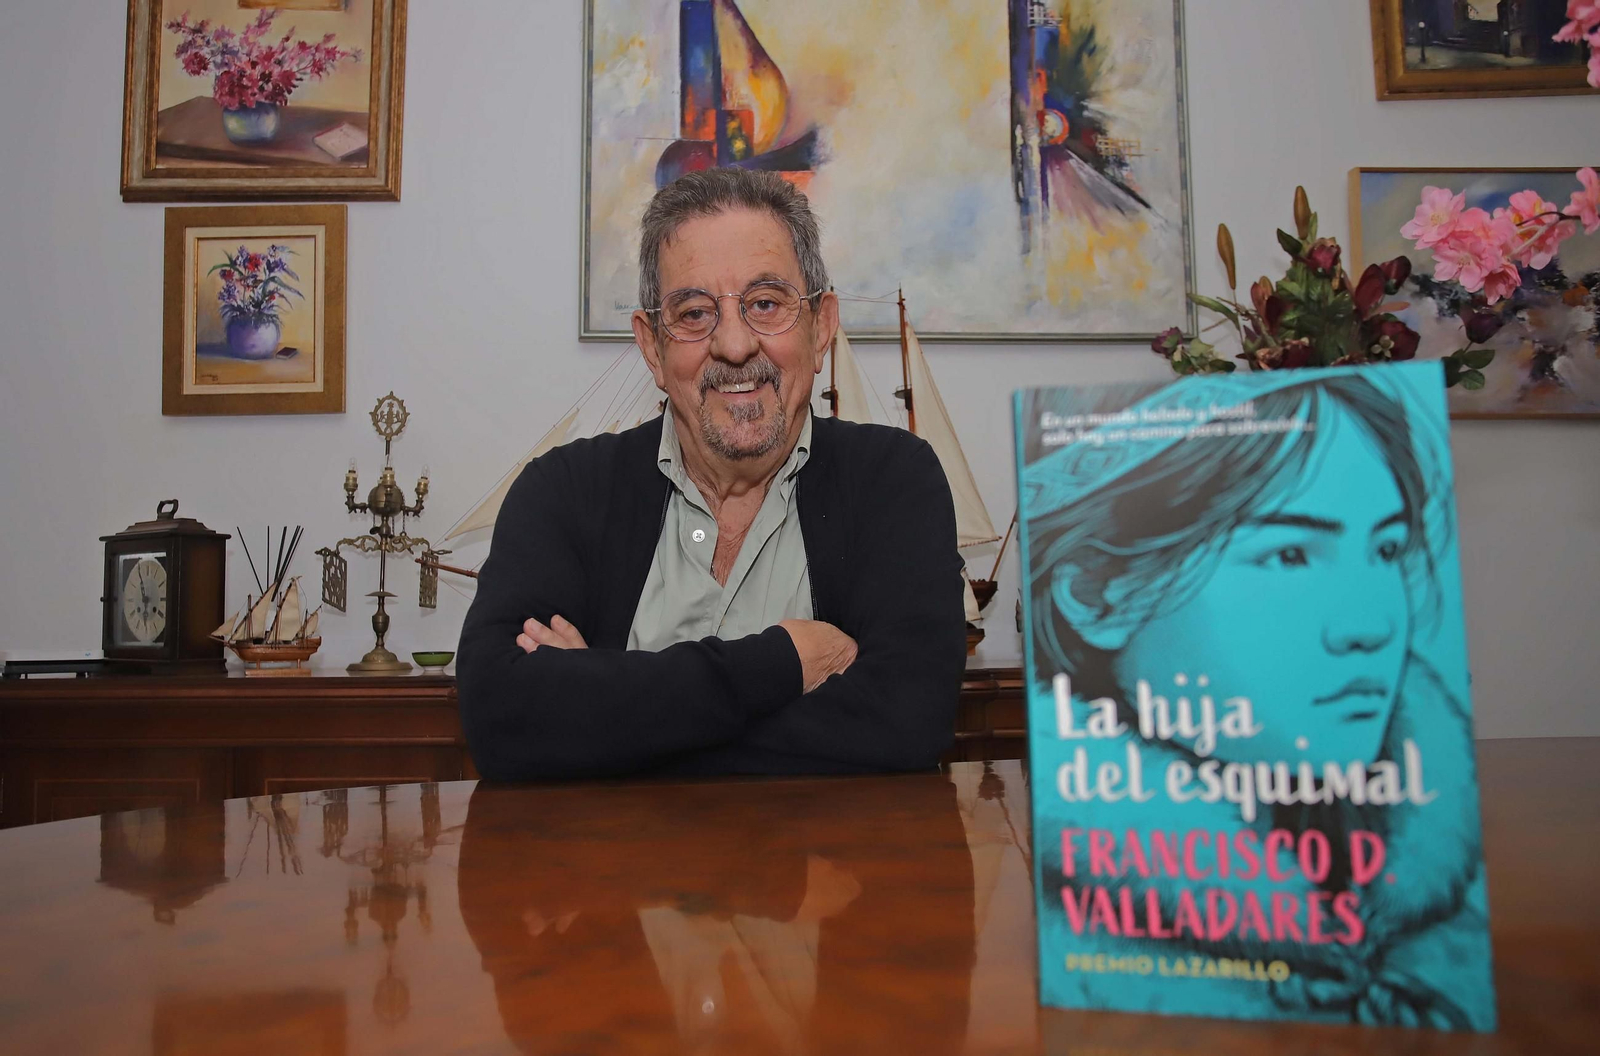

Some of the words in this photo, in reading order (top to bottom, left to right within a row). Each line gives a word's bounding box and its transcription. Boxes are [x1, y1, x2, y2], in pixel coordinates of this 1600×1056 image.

[1053, 672, 1128, 739] La
[1136, 672, 1264, 757] hija
[1057, 741, 1156, 803] del
[1165, 736, 1440, 823] esquimal
[1061, 827, 1331, 884] FRANCISCO
[1350, 830, 1396, 885] D.
[1061, 886, 1366, 945] VALLADARES
[1065, 952, 1154, 976] PREMIO
[1157, 956, 1291, 982] LAZARILLO
